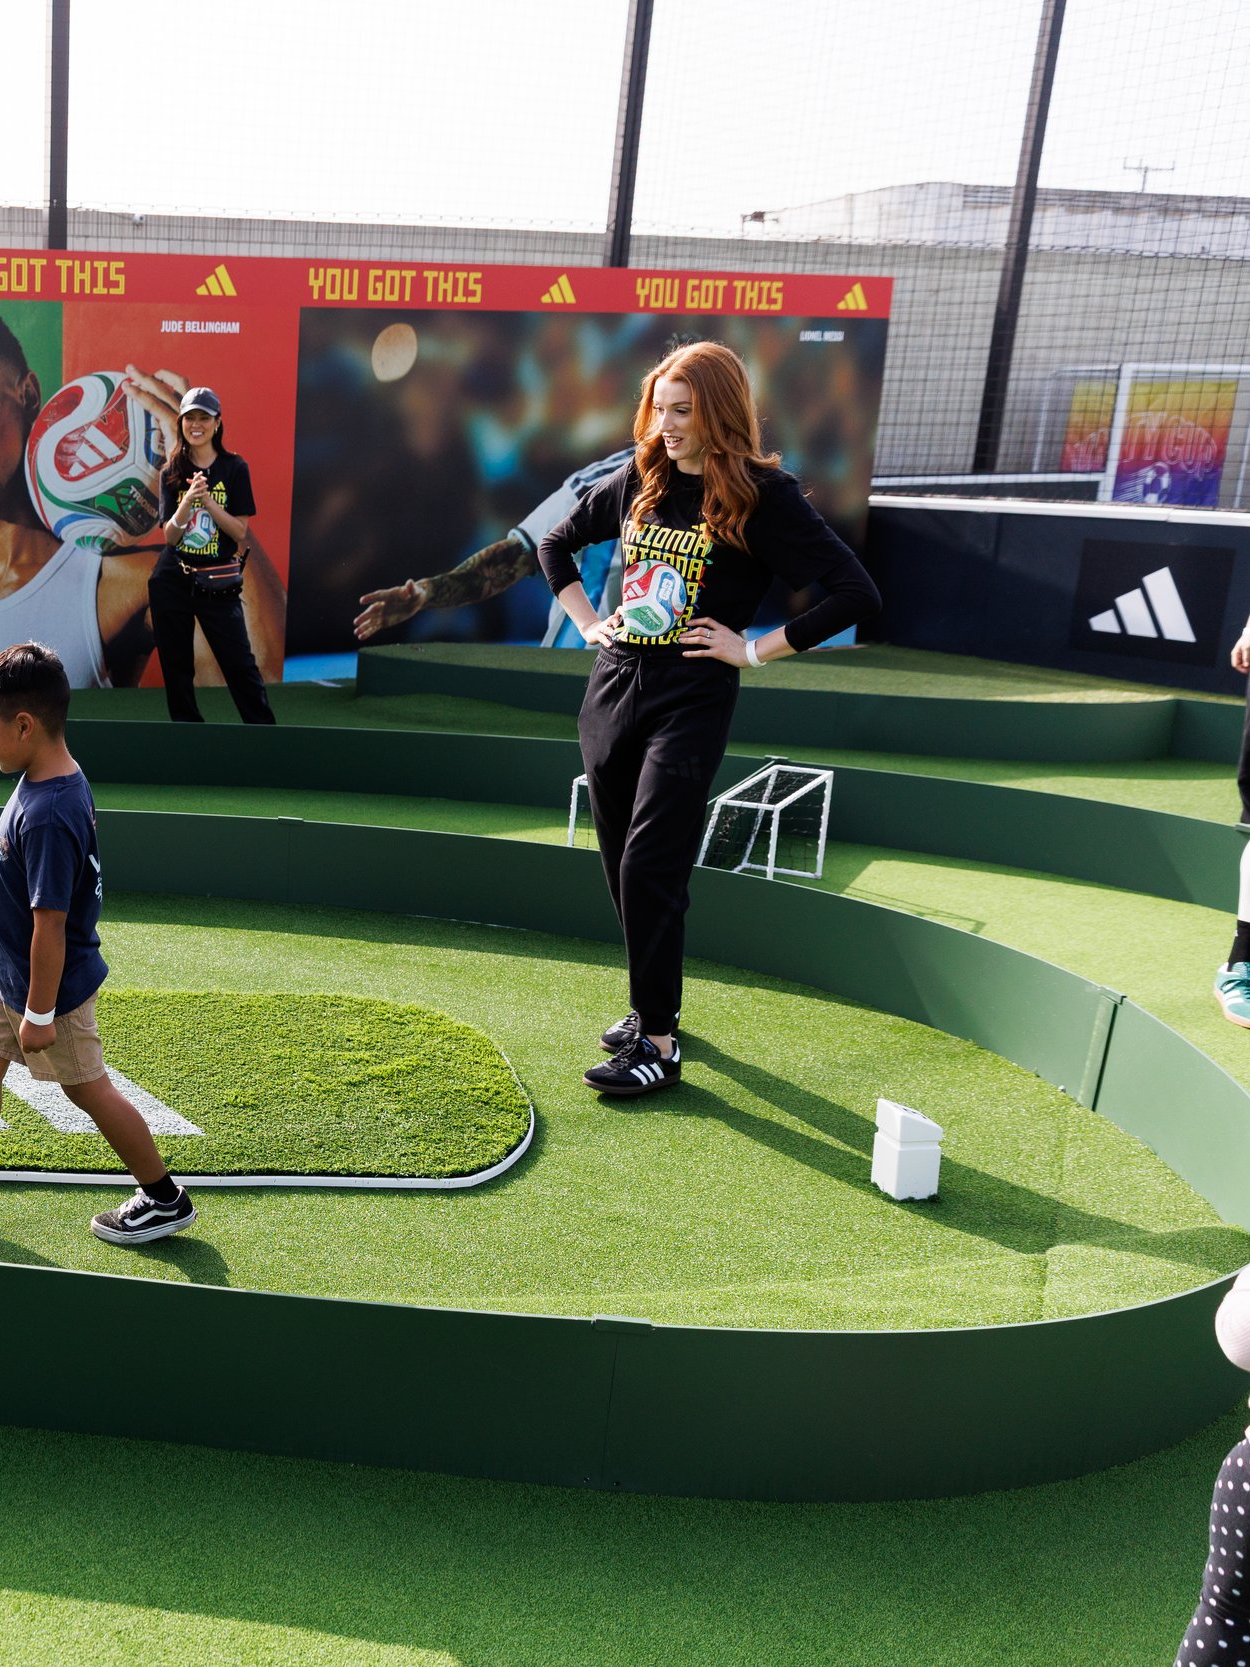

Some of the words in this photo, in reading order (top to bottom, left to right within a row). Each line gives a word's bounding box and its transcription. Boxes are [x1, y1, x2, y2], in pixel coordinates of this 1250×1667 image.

[55, 259, 125, 295] THIS
[308, 267, 359, 301] YOU
[367, 269, 416, 302] GOT
[423, 270, 482, 304] THIS
[636, 277, 680, 309] YOU
[685, 278, 728, 310] GOT
[732, 280, 784, 311] THIS
[160, 320, 184, 333] JUDE
[184, 320, 240, 334] BELLINGHAM
